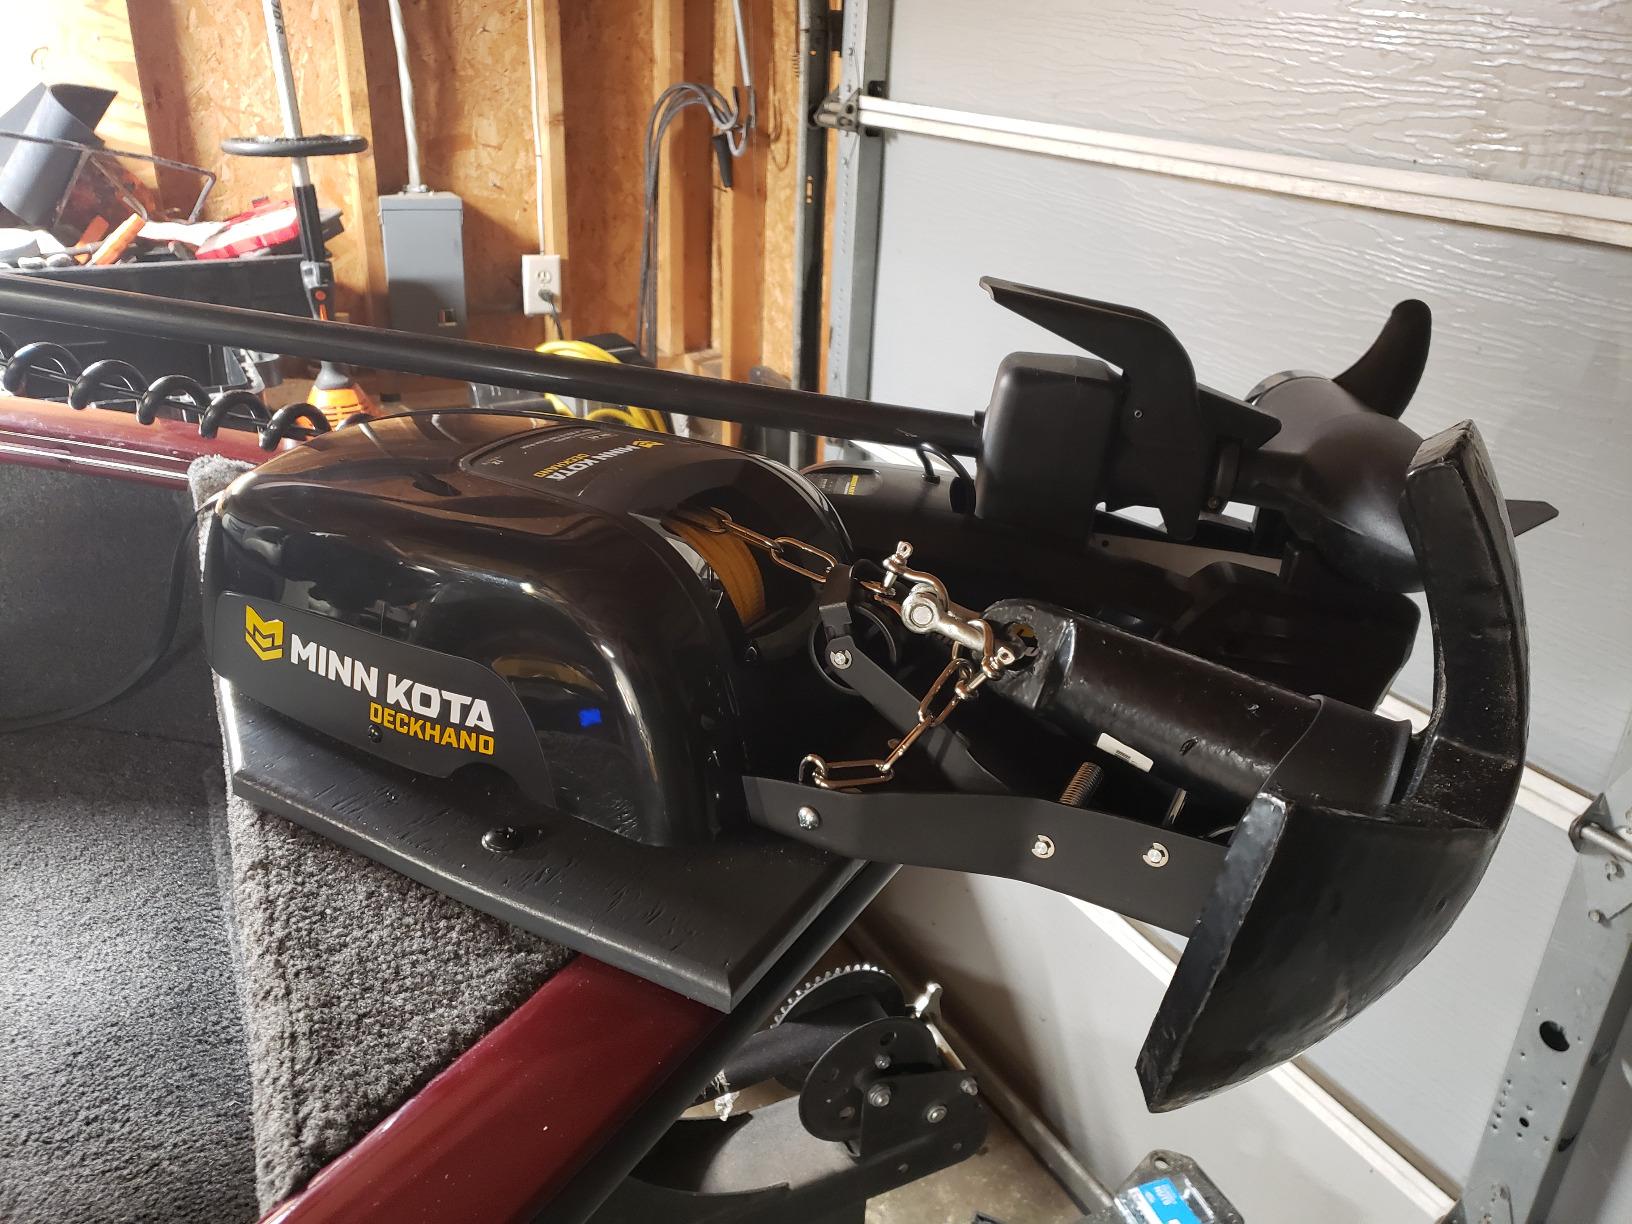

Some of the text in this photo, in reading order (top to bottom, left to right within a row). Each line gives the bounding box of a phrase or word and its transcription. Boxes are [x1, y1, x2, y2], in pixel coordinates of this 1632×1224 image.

[533, 453, 591, 478] DECKHAND
[545, 444, 641, 481] MINN KOTA
[290, 633, 495, 733] MINN KOTA
[369, 701, 495, 756] DECKHAND
